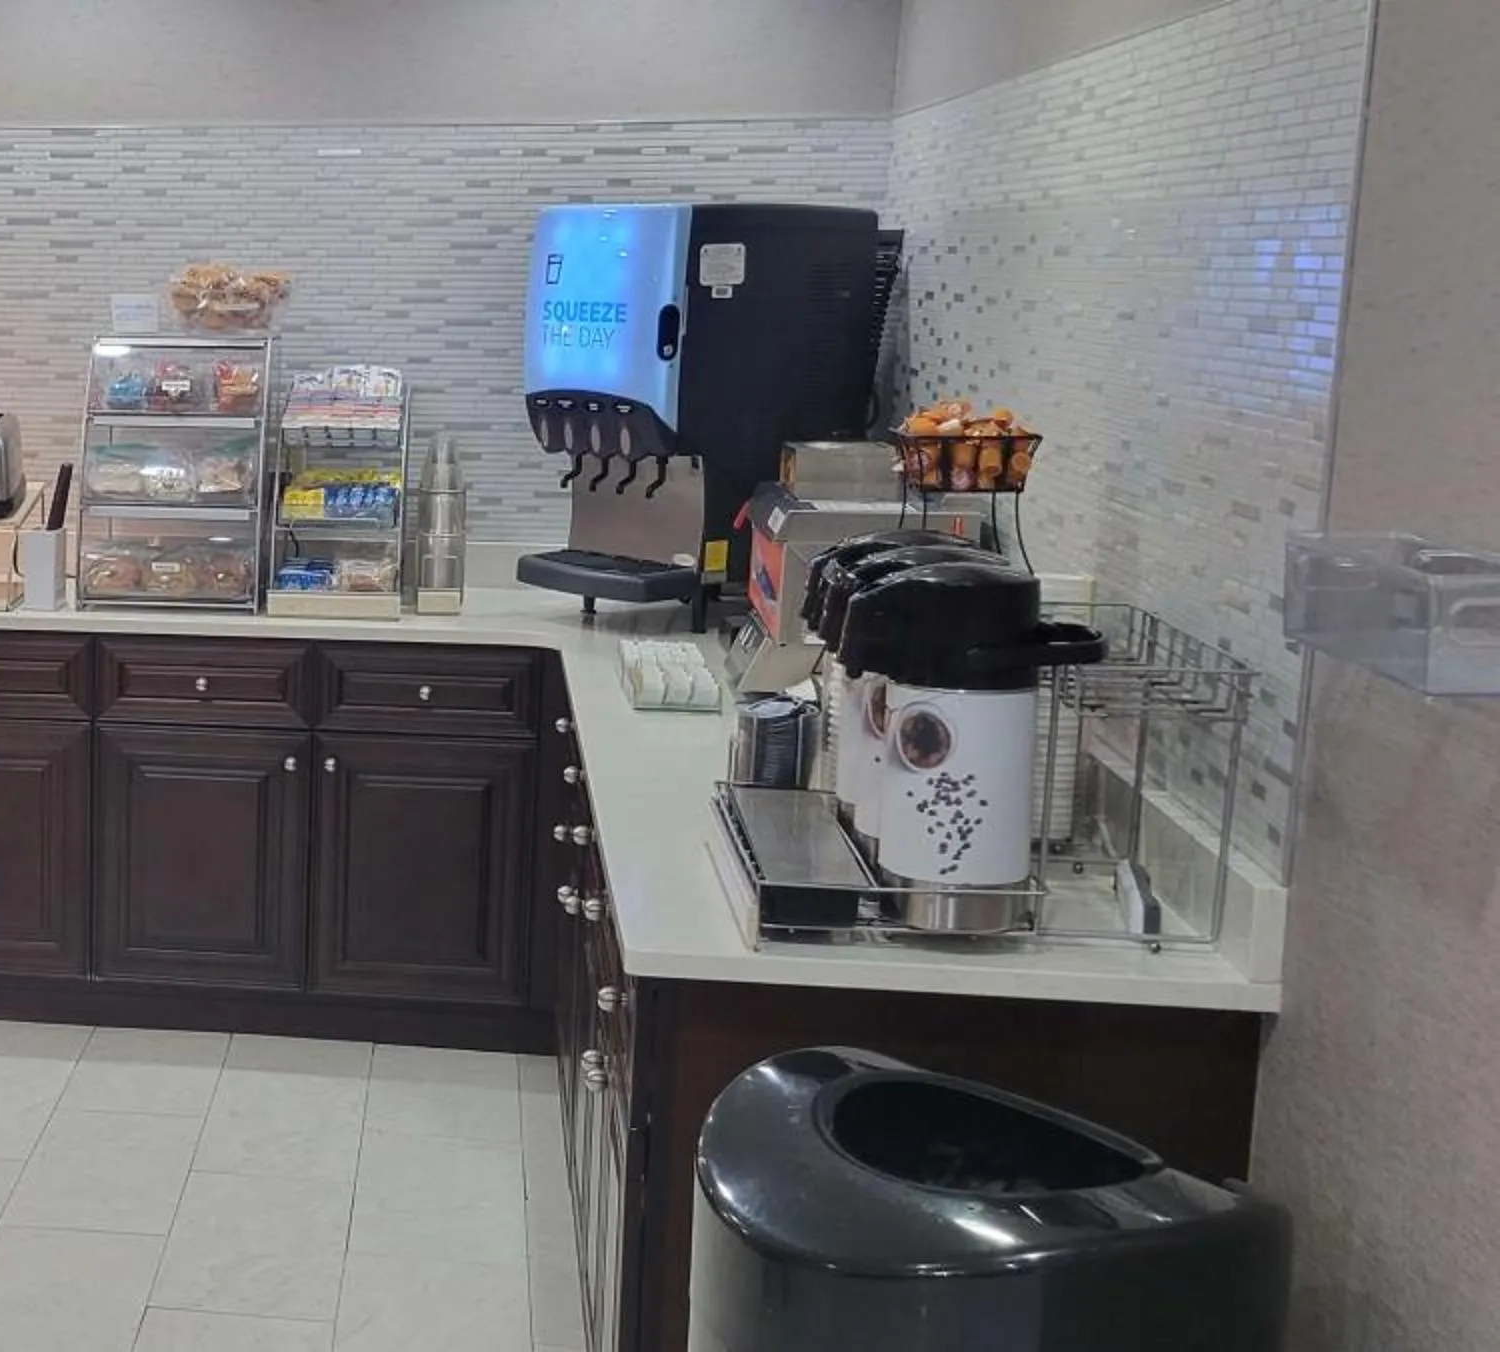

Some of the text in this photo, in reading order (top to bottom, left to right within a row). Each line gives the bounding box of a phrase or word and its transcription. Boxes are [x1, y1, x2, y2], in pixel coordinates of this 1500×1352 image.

[542, 300, 627, 323] SQUEEZE
[542, 324, 615, 350] THE DAY
